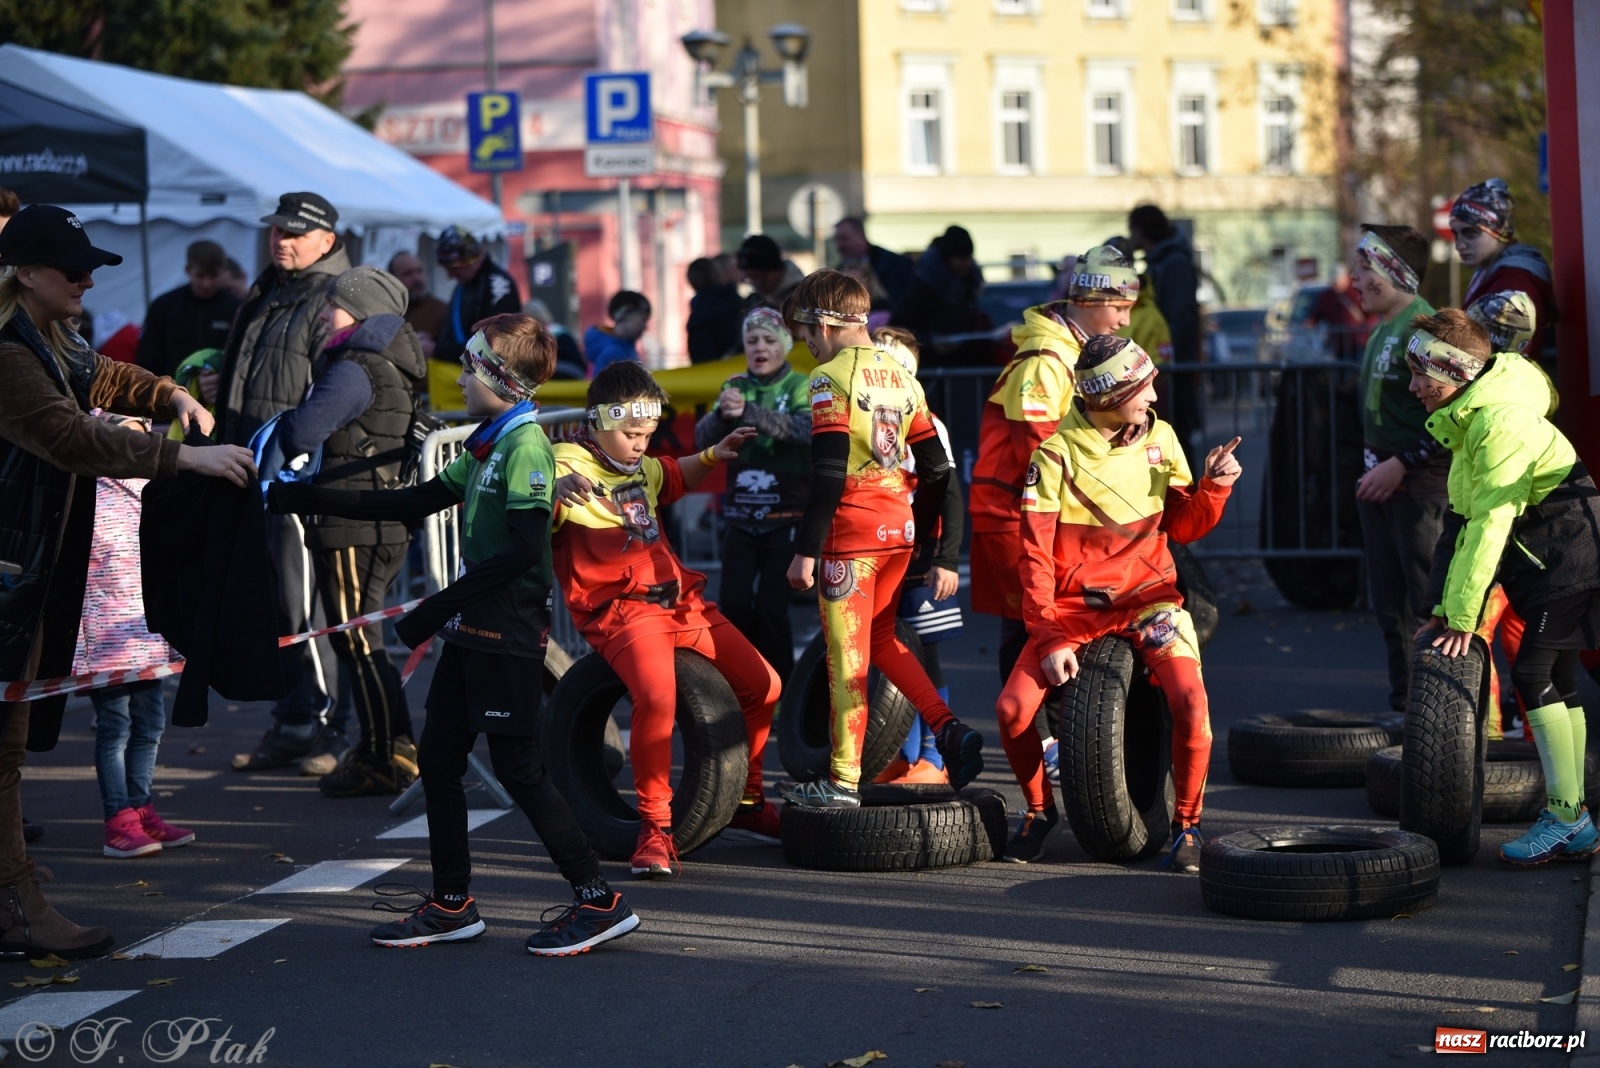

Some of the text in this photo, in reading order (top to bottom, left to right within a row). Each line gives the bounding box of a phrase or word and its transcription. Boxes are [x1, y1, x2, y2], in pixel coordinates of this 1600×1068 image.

[480, 95, 511, 132] P
[596, 78, 641, 138] P
[1078, 273, 1112, 289] ELITA
[1082, 372, 1118, 395] ELITA
[613, 408, 622, 417] B
[1538, 611, 1549, 633] KIPSTA
